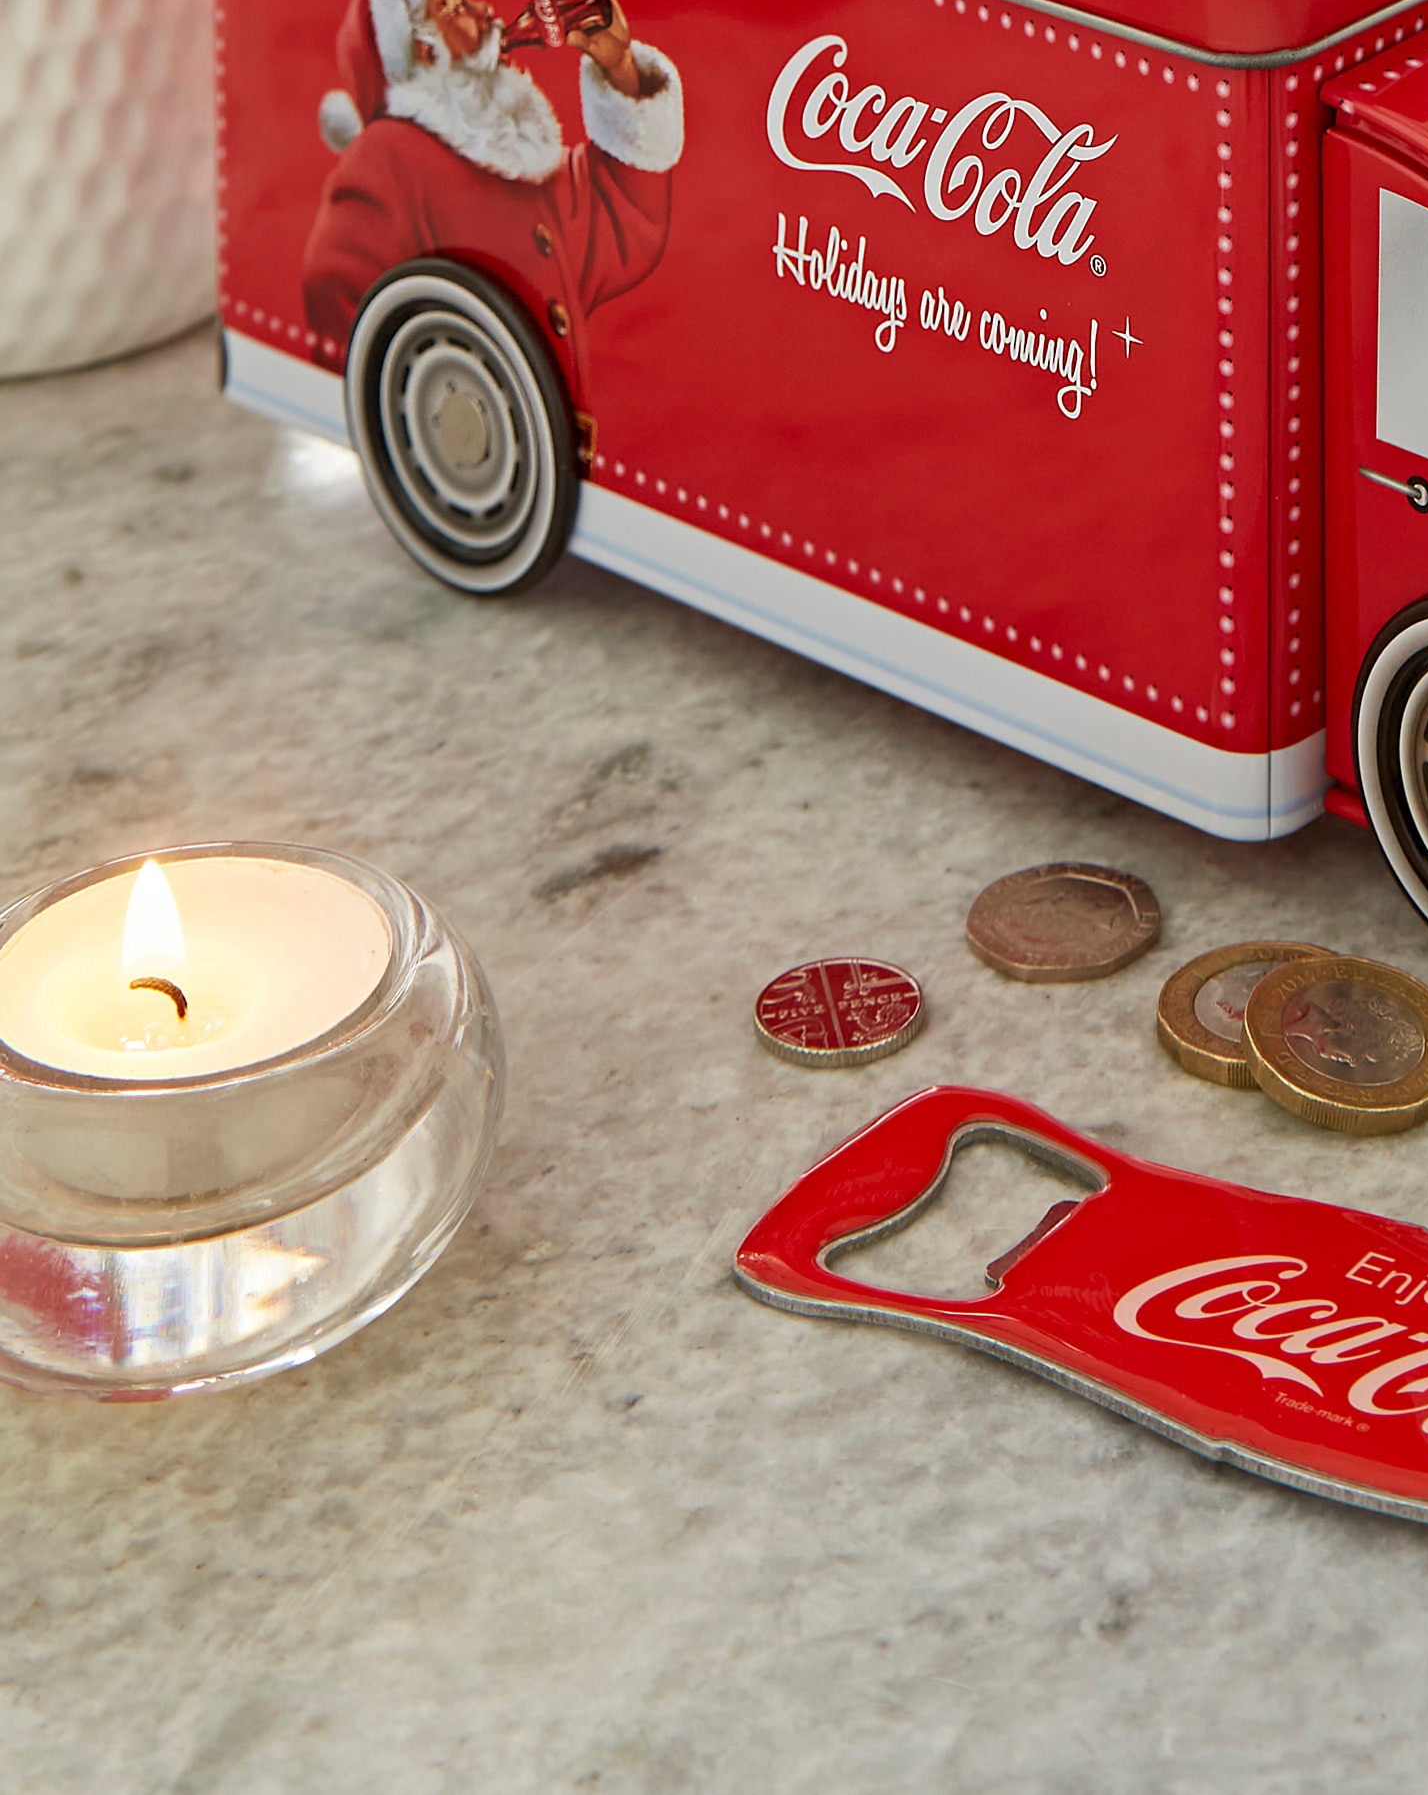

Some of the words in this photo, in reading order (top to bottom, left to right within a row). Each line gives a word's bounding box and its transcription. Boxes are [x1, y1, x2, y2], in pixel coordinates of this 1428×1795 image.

[772, 212, 907, 353] Holidays
[920, 286, 971, 342] are
[979, 308, 1099, 420] coming!
[837, 992, 903, 1010] PENCE
